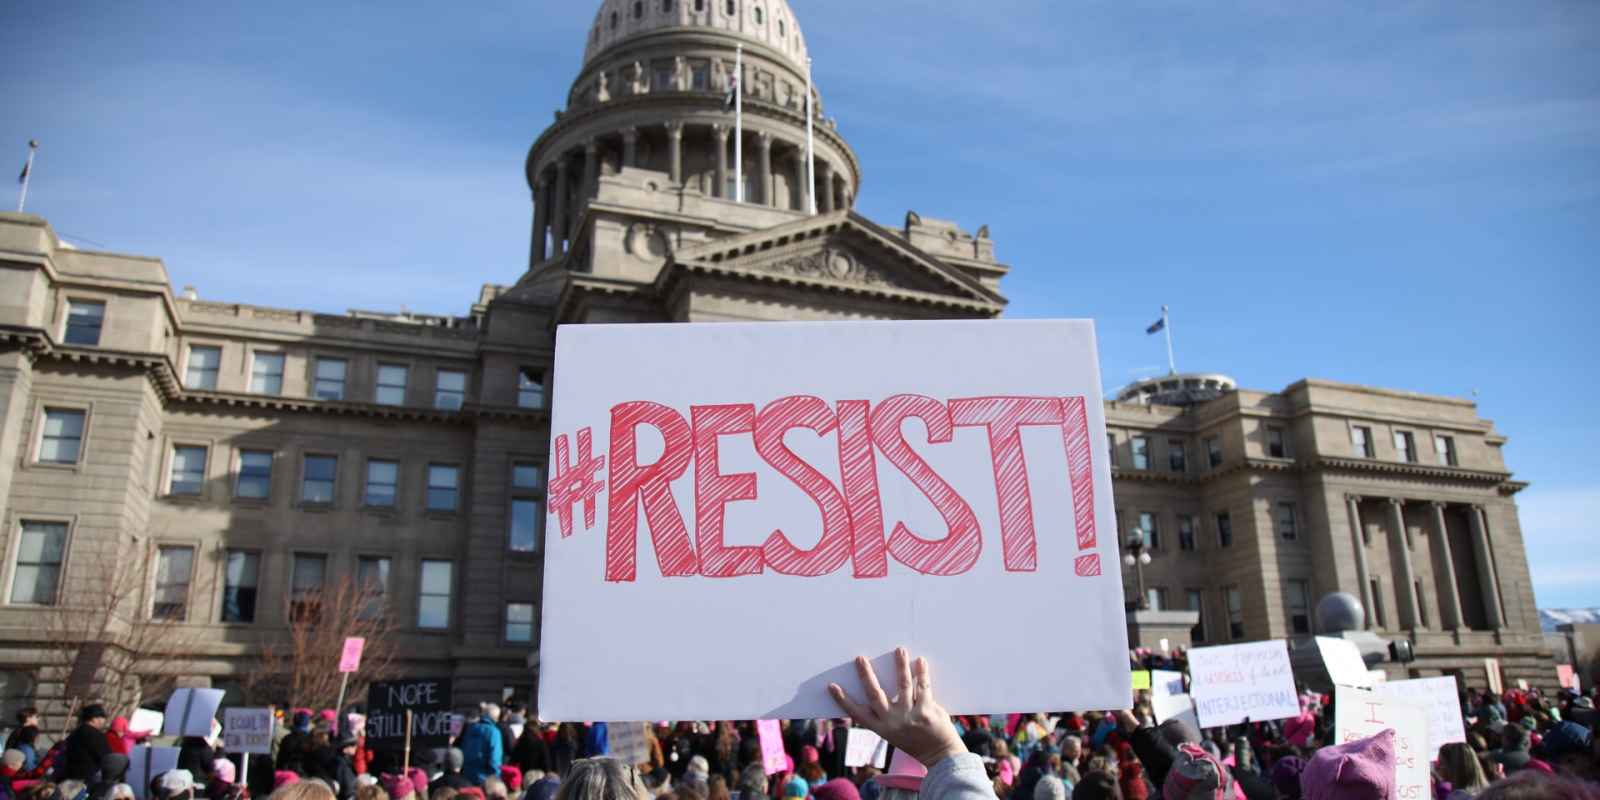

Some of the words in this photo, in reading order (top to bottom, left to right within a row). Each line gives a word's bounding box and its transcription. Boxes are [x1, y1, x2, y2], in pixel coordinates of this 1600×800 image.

[549, 394, 1100, 582] #RESIST!
[367, 709, 405, 738] STILL
[1364, 702, 1385, 724] I
